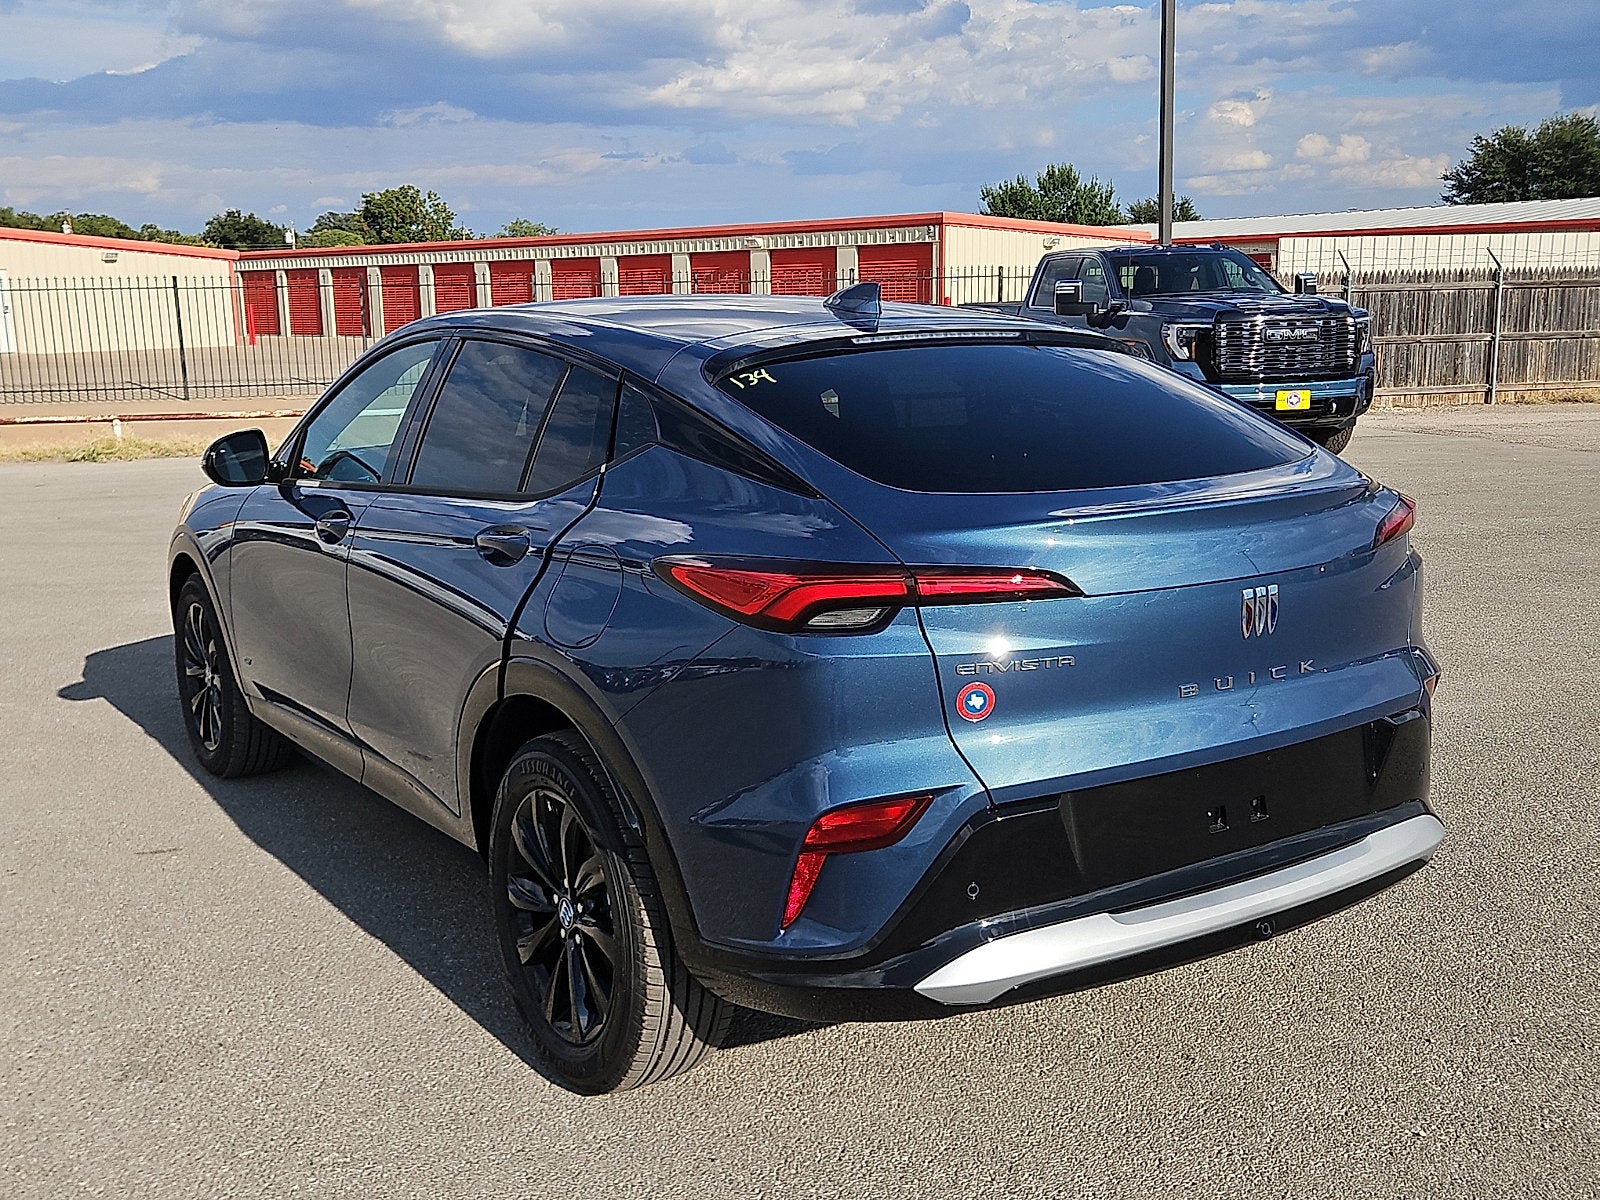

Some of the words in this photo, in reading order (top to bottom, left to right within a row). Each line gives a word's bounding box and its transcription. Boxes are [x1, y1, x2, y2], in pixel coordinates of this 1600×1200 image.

[1266, 328, 1319, 341] GMC
[729, 368, 778, 390] 134
[955, 655, 1077, 676] ENVISTA
[1178, 659, 1316, 698] BUICK
